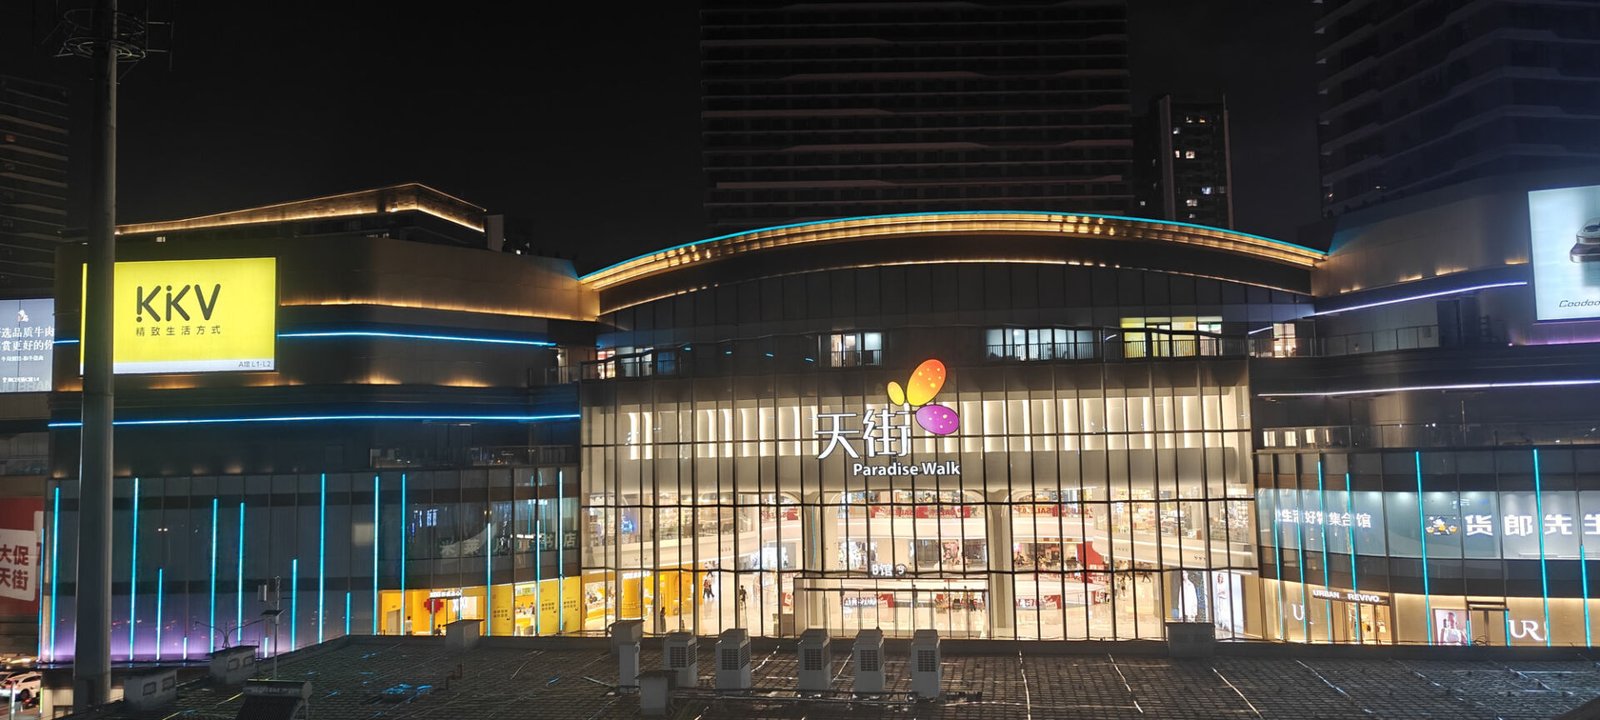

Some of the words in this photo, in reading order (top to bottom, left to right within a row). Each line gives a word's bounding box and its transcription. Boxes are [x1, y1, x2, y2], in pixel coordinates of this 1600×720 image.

[136, 283, 221, 323] KKV
[0, 326, 55, 339] 选品质牛肉
[135, 325, 221, 337] 精致生活方式
[0, 339, 53, 352] 赏更好的你
[815, 407, 911, 459] 天街
[853, 462, 919, 476] Paradise
[921, 462, 961, 476] Walk
[1464, 513, 1600, 537] 货郎先生
[0, 544, 29, 566] 大促
[0, 567, 29, 591] 天街
[1312, 589, 1340, 599] URBAN
[1347, 593, 1380, 603] REVIVO
[1508, 619, 1544, 641] UR
